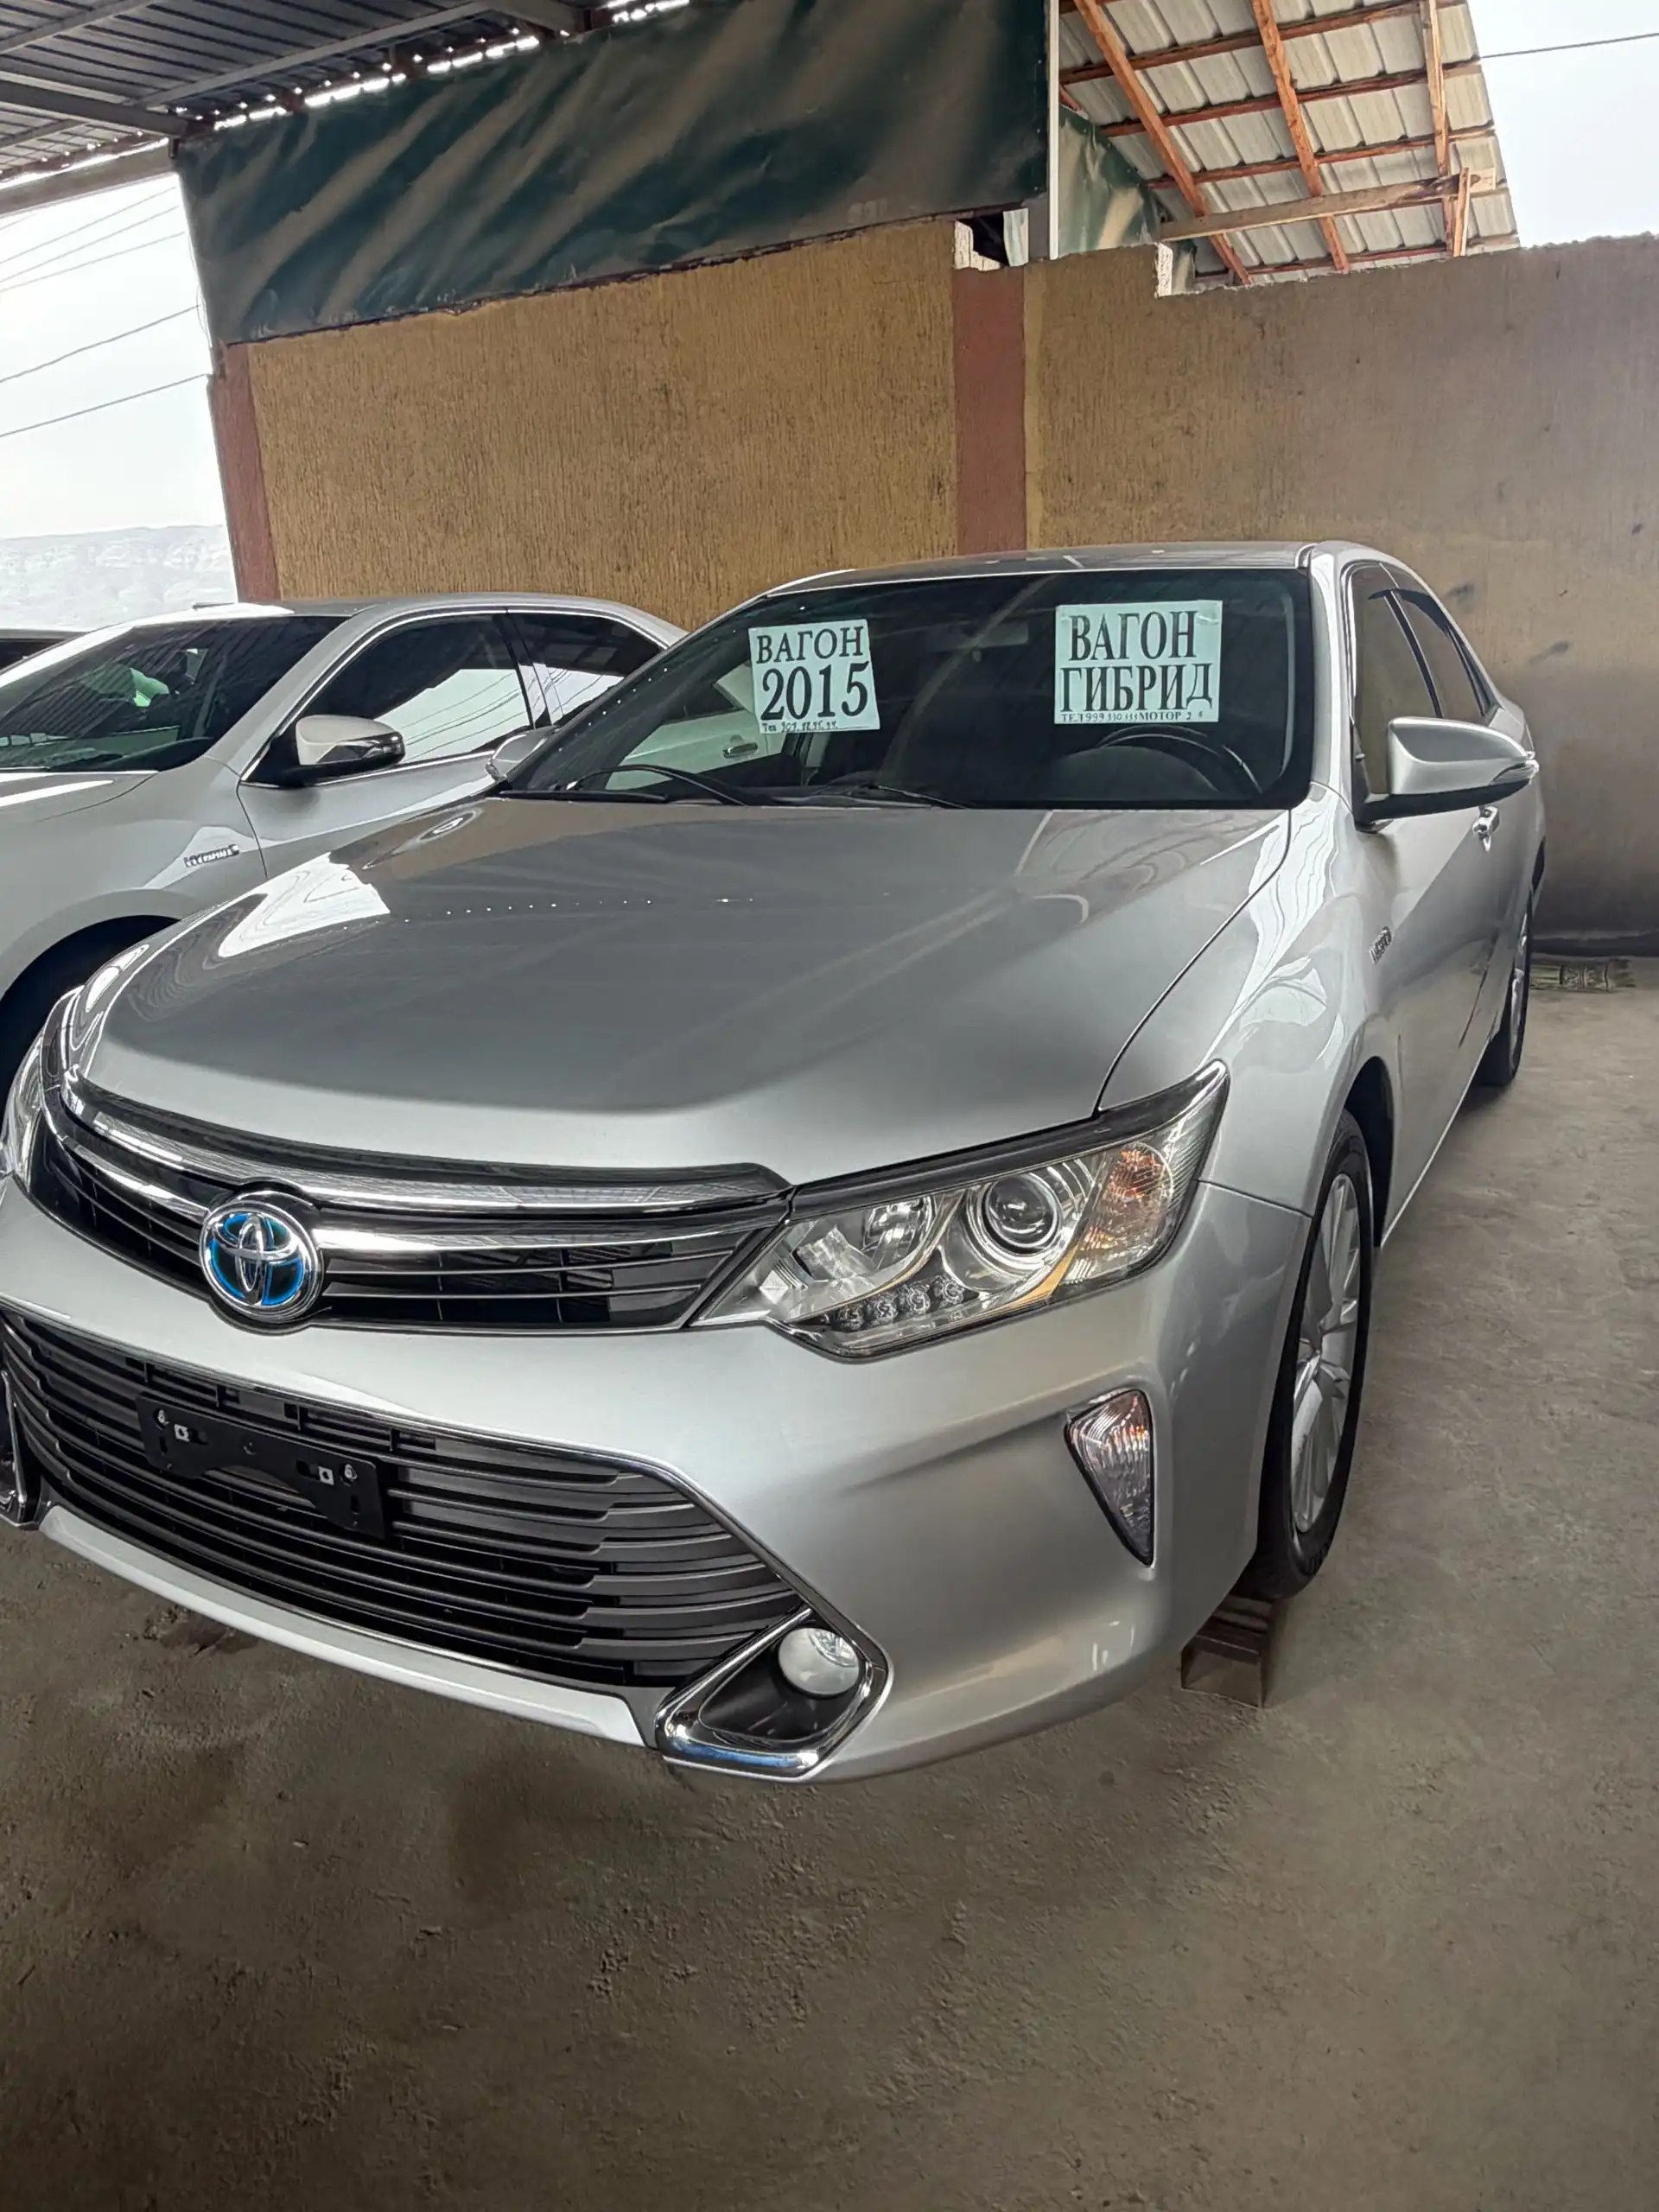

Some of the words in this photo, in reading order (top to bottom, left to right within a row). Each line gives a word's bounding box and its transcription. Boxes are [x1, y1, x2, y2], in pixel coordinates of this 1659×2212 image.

[756, 626, 864, 664] ВАГОН
[1068, 610, 1198, 660] ВАГОН
[760, 660, 870, 721] 2015
[1060, 662, 1213, 713] ГИБРИД
[1139, 711, 1182, 721] МОТОР
